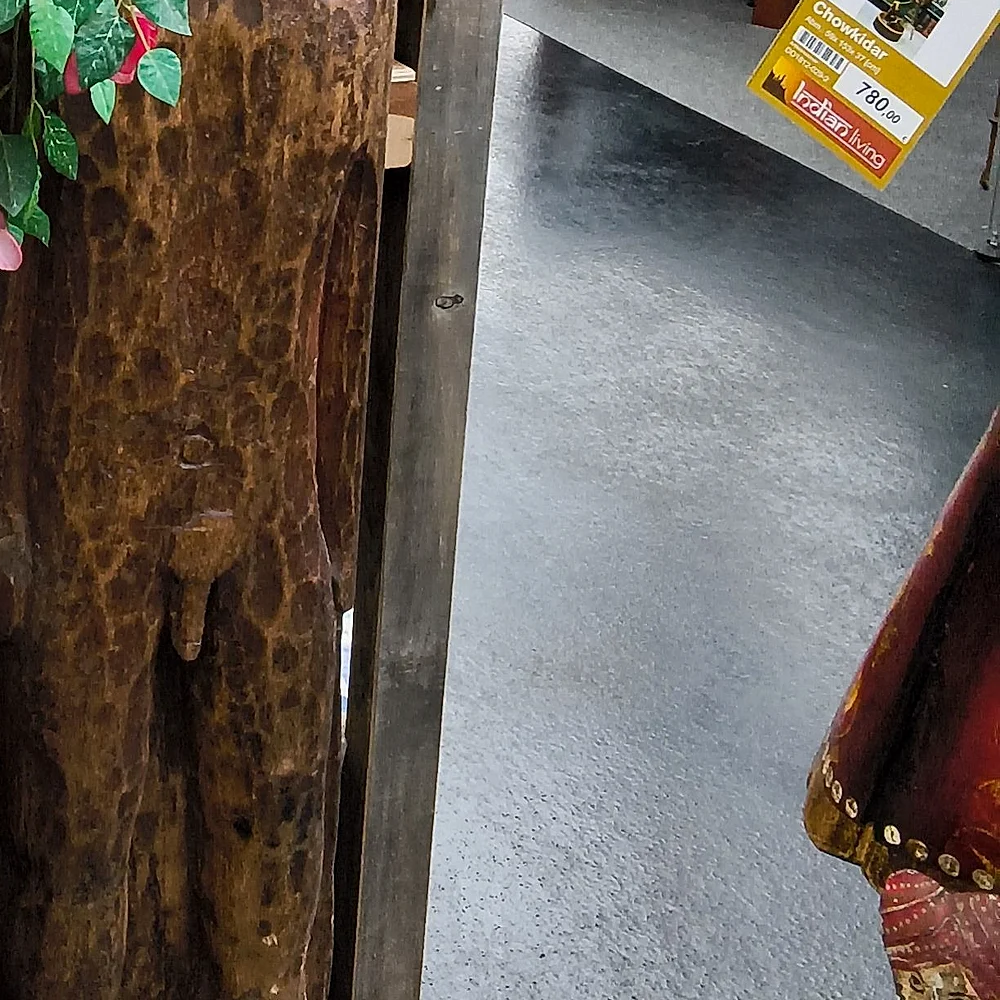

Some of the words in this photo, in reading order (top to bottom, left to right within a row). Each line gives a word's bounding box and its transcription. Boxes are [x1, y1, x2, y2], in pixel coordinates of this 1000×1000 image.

[813, 1, 889, 60] Chowkidar
[792, 80, 853, 137] Indian
[847, 128, 887, 170] living
[855, 81, 901, 124] 780,00
